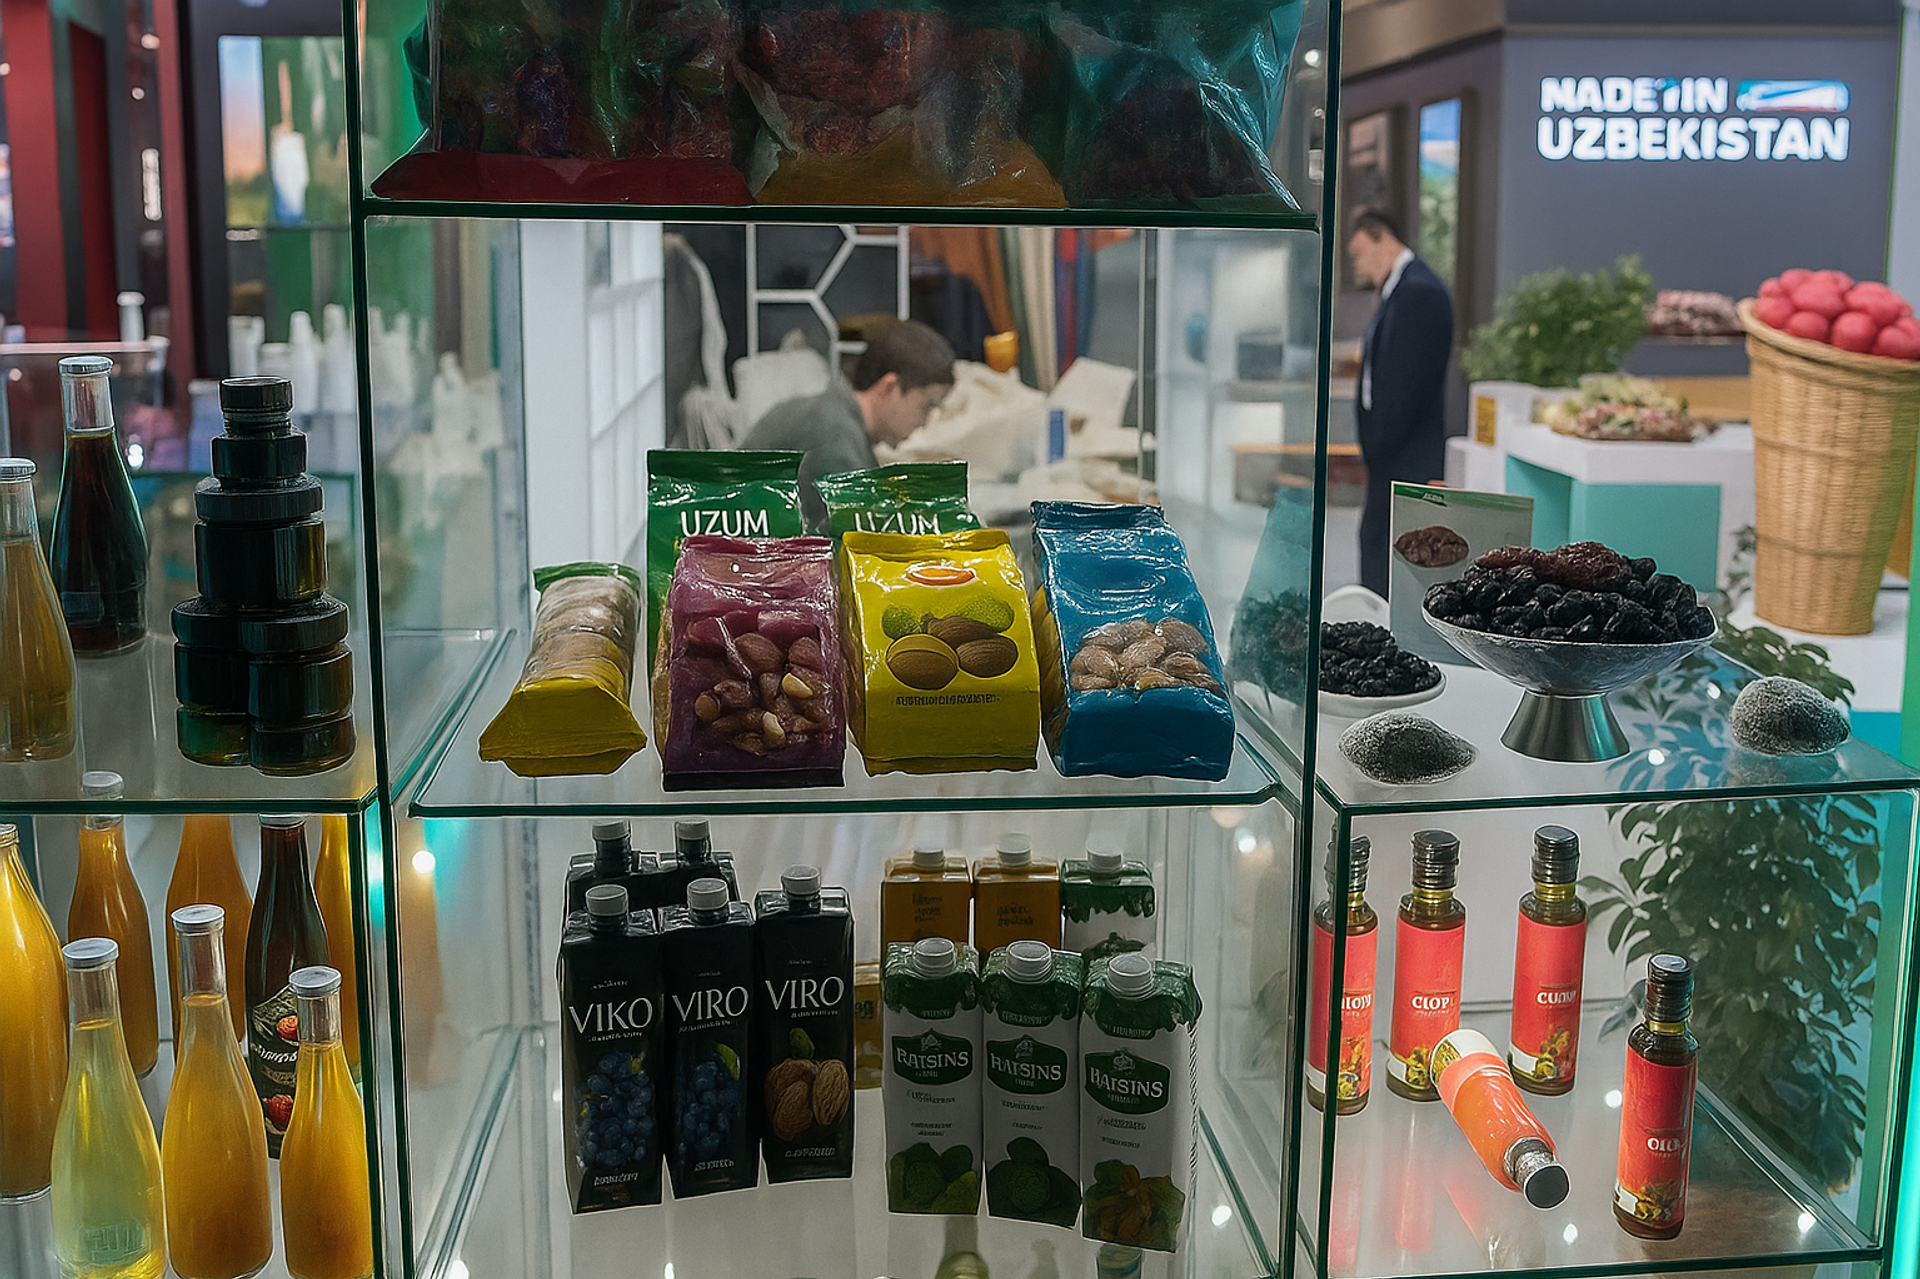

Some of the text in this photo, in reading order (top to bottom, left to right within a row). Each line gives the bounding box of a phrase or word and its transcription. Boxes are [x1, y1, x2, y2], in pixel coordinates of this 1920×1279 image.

[1537, 116, 1849, 161] UZBEKISTAN
[680, 508, 770, 537] UZUM
[854, 511, 941, 537] UZUM
[672, 986, 749, 1023] VIRO
[764, 976, 845, 1011] VIRO
[568, 997, 654, 1034] VIKO
